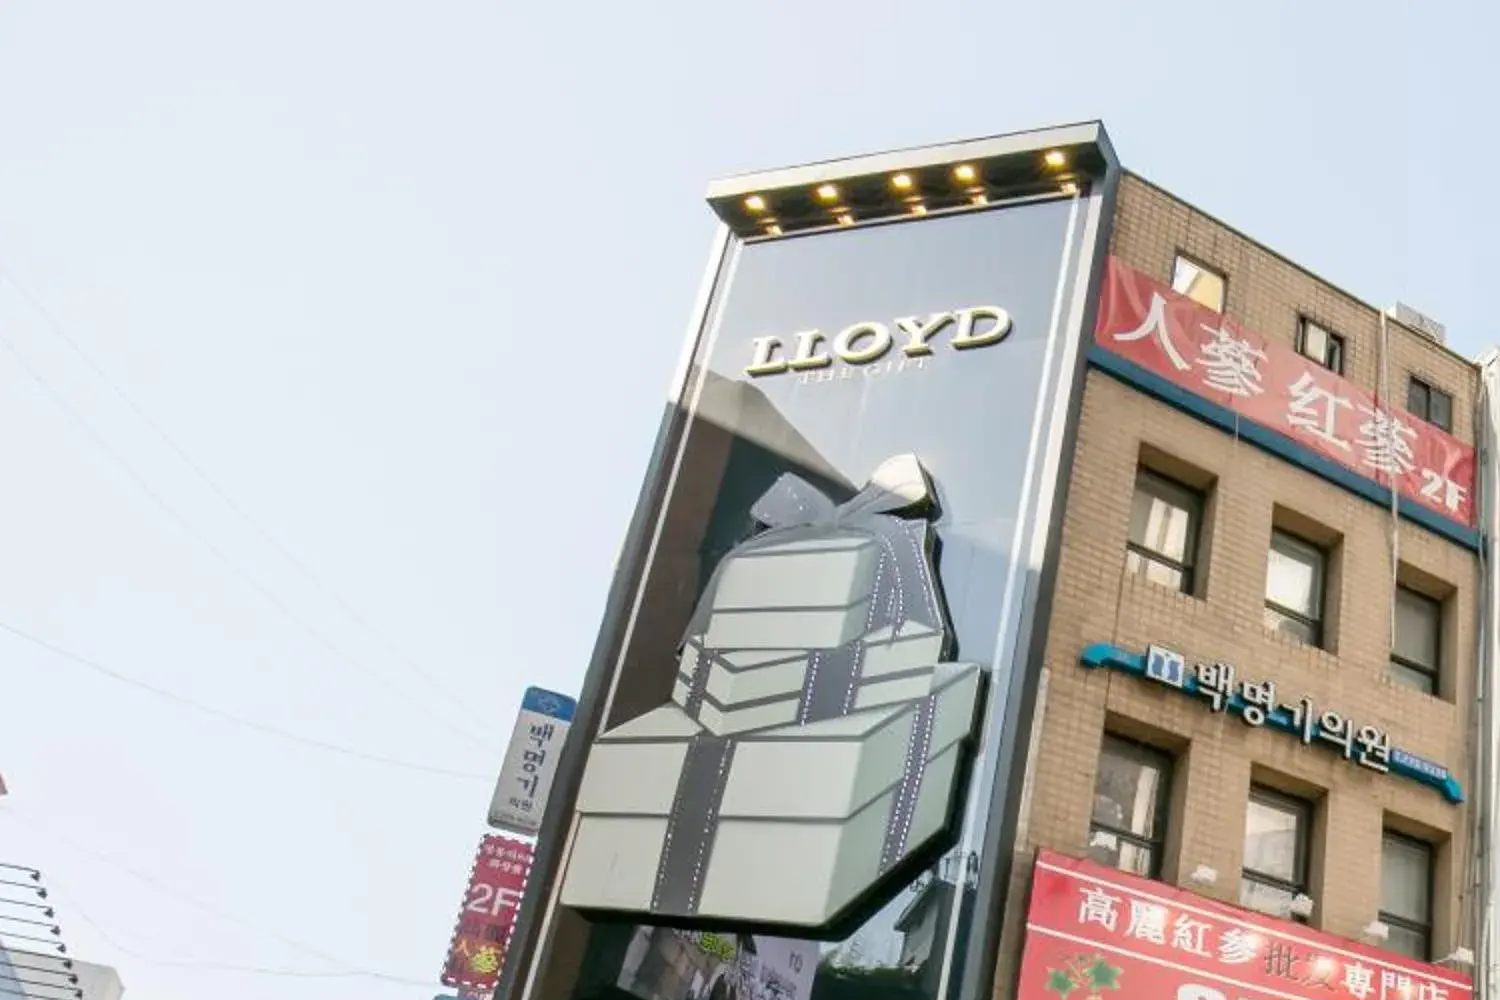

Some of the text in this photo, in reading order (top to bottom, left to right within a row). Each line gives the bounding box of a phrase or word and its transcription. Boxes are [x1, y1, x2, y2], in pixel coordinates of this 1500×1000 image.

[744, 304, 1013, 378] LLOYD
[1420, 469, 1467, 513] 2F
[1195, 661, 1390, 774] 백명기의원
[466, 882, 521, 918] 2F
